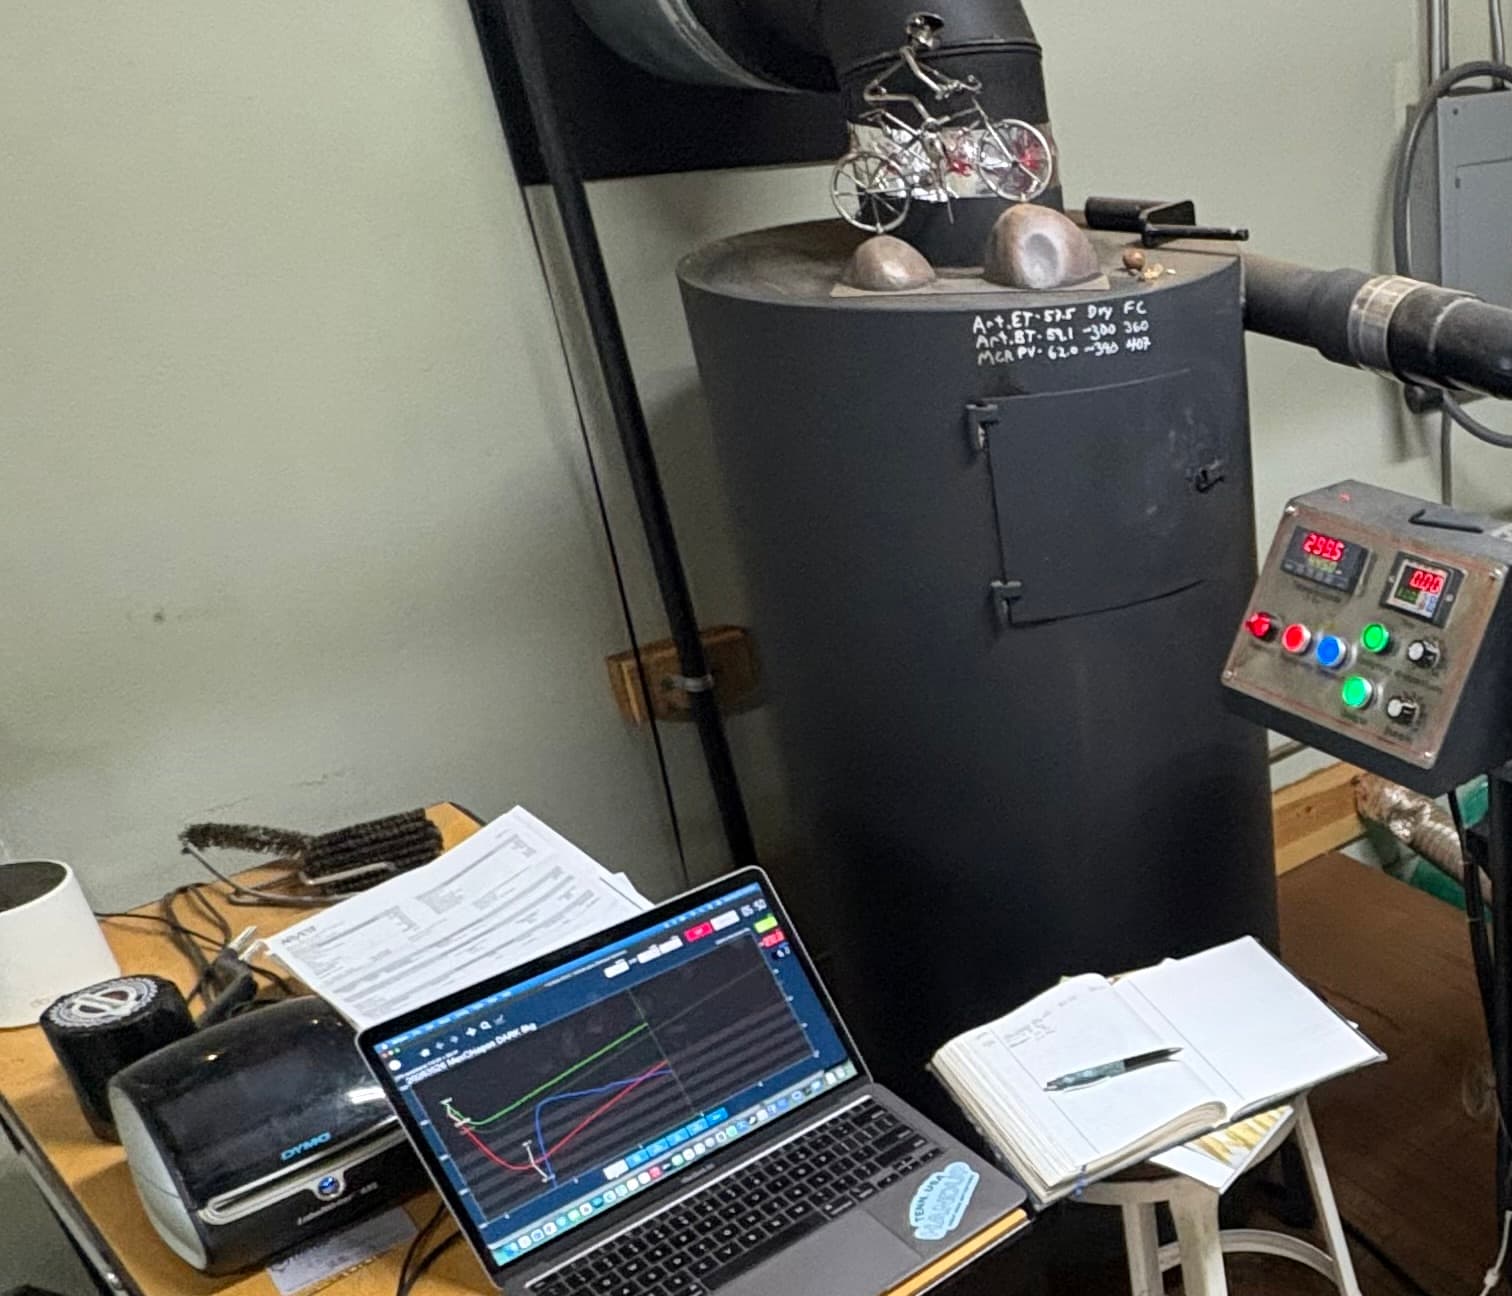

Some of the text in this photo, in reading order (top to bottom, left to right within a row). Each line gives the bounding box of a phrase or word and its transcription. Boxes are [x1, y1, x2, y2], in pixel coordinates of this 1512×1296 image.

[1087, 304, 1113, 321] Dry
[1123, 300, 1148, 315] FC
[1123, 320, 1150, 334] 360
[1125, 336, 1152, 352] 407
[281, 1131, 332, 1161] DYMO
[914, 1175, 943, 1222] TENN USA
